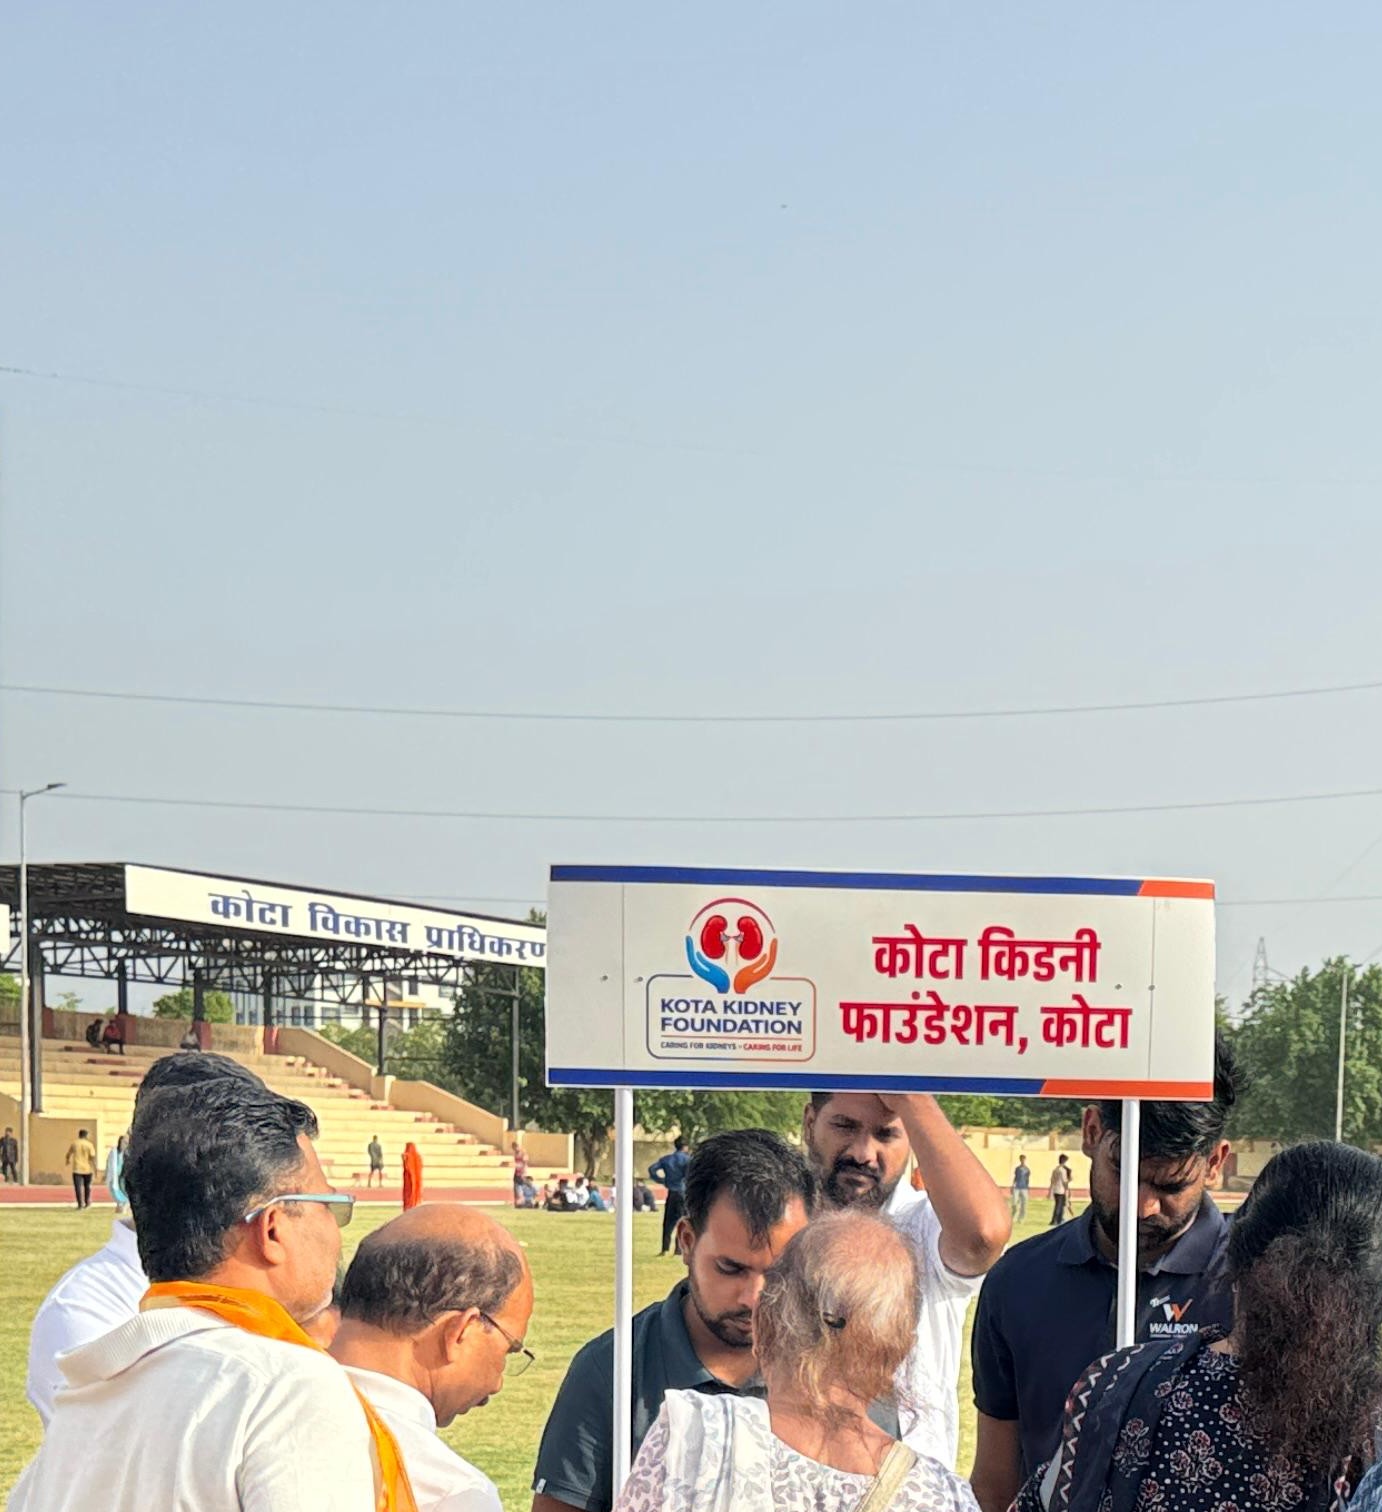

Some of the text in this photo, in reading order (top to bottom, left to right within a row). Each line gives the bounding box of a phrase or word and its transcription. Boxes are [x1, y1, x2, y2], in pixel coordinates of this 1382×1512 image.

[208, 890, 293, 928] कोटा
[308, 902, 411, 944] विकास
[872, 924, 1102, 983] कोटा किडनी
[661, 998, 802, 1016] KOTA KIDNEY
[661, 1017, 802, 1034] FOUNDATION
[839, 990, 1133, 1055] फाउंडेशन, कोटा
[661, 1041, 688, 1049] CARING
[743, 1043, 771, 1051] CARING
[772, 1044, 787, 1052] FOR
[788, 1044, 802, 1052] LIFE
[1150, 1323, 1199, 1334] WALRON
